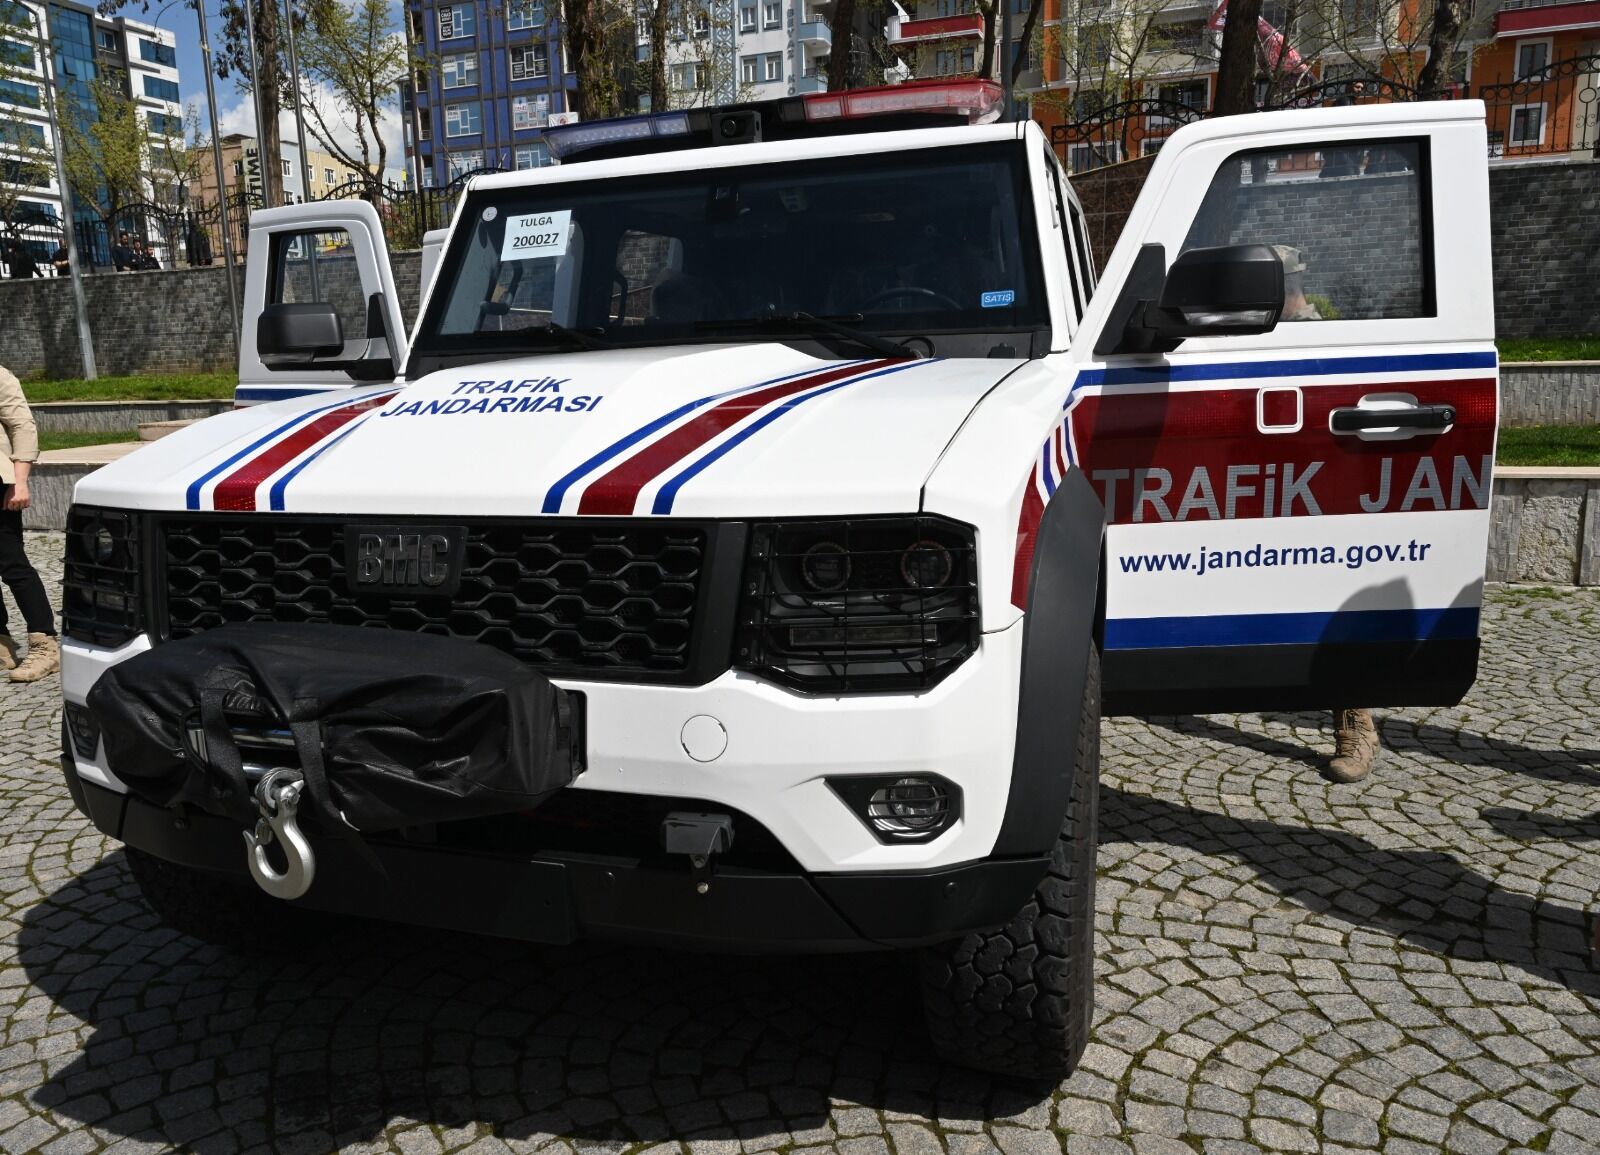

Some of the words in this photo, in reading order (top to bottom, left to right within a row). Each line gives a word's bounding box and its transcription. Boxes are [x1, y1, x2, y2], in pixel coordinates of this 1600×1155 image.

[519, 216, 553, 228] TULGA
[512, 232, 560, 248] 200027
[450, 376, 572, 395] TRAFİK
[379, 395, 604, 417] JANDARMASI
[1359, 454, 1493, 513] JAN
[357, 534, 449, 586] BMC
[1118, 540, 1432, 575] www.jandarma.gov.tr
